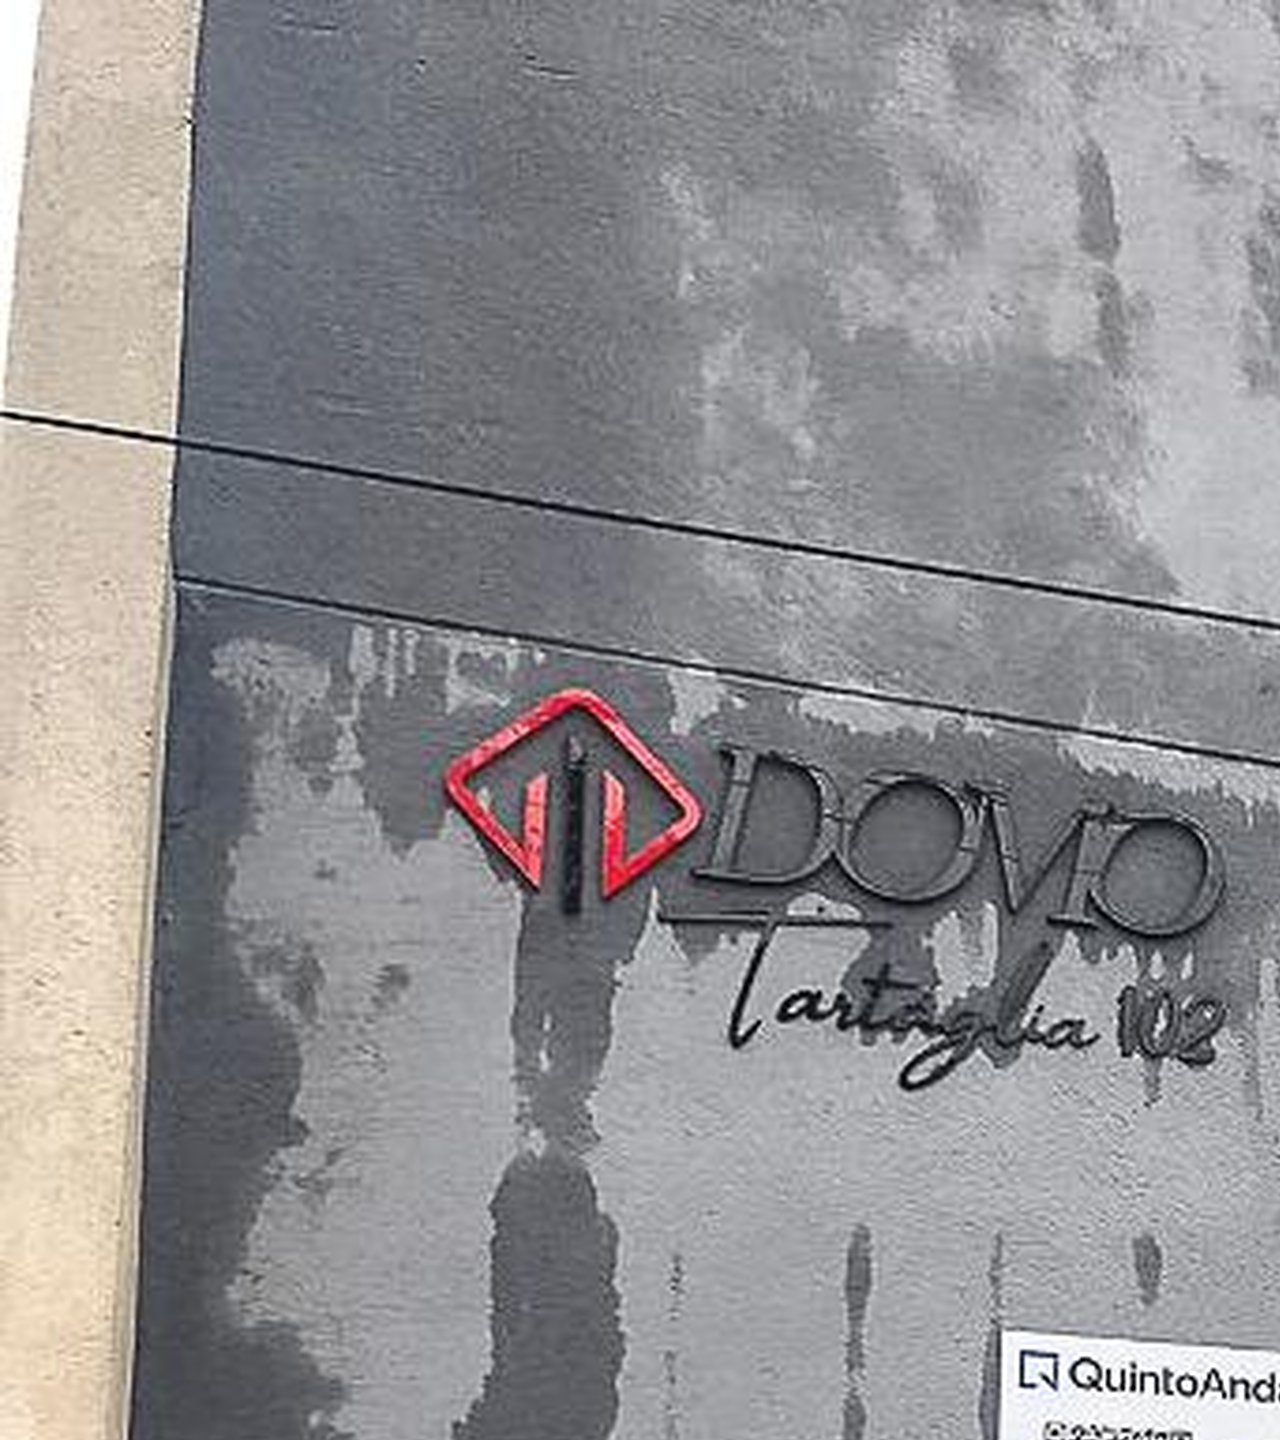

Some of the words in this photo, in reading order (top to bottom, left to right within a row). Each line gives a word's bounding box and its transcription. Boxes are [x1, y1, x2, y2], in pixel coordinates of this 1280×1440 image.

[690, 744, 1226, 938] DOMO
[658, 909, 1101, 1091] Tartaglia
[1116, 985, 1228, 1067] 102
